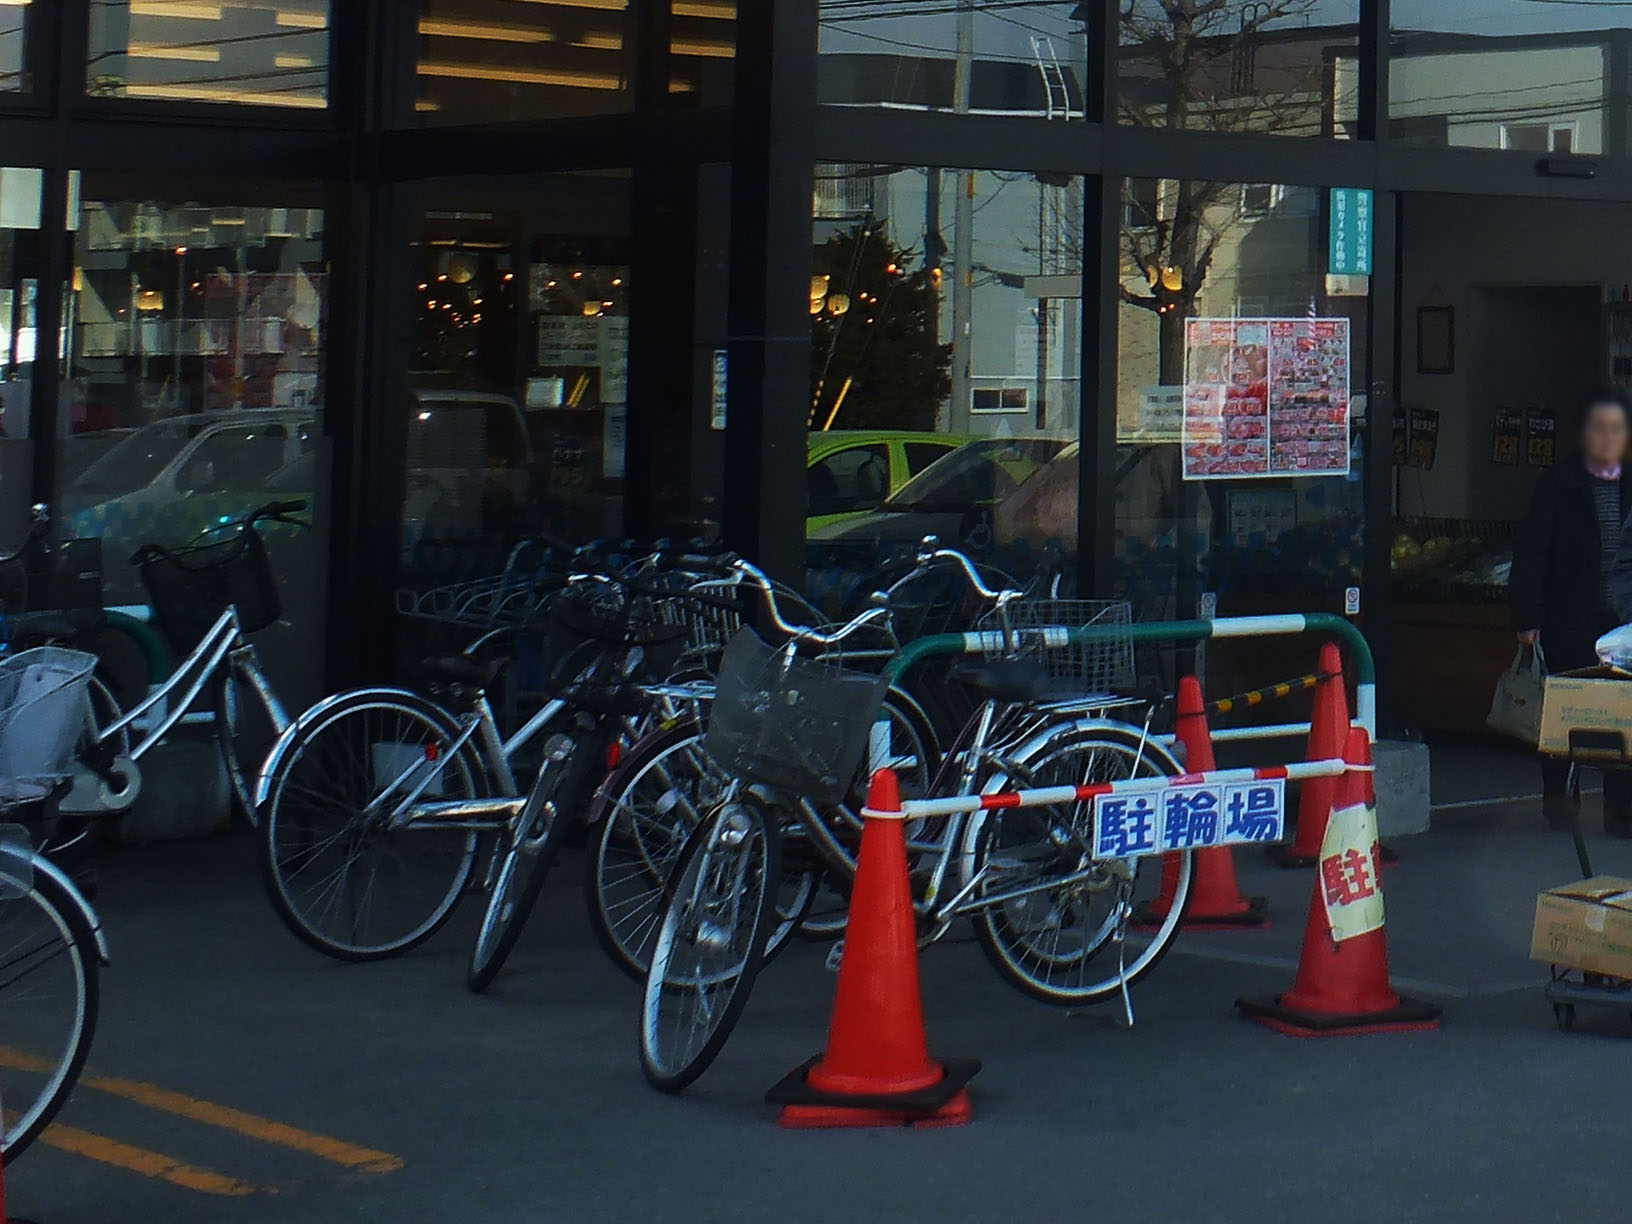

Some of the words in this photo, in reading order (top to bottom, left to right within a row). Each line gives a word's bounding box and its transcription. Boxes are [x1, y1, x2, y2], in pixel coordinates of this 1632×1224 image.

[1098, 787, 1280, 857] 駐輪場
[1323, 839, 1382, 908] 駐
